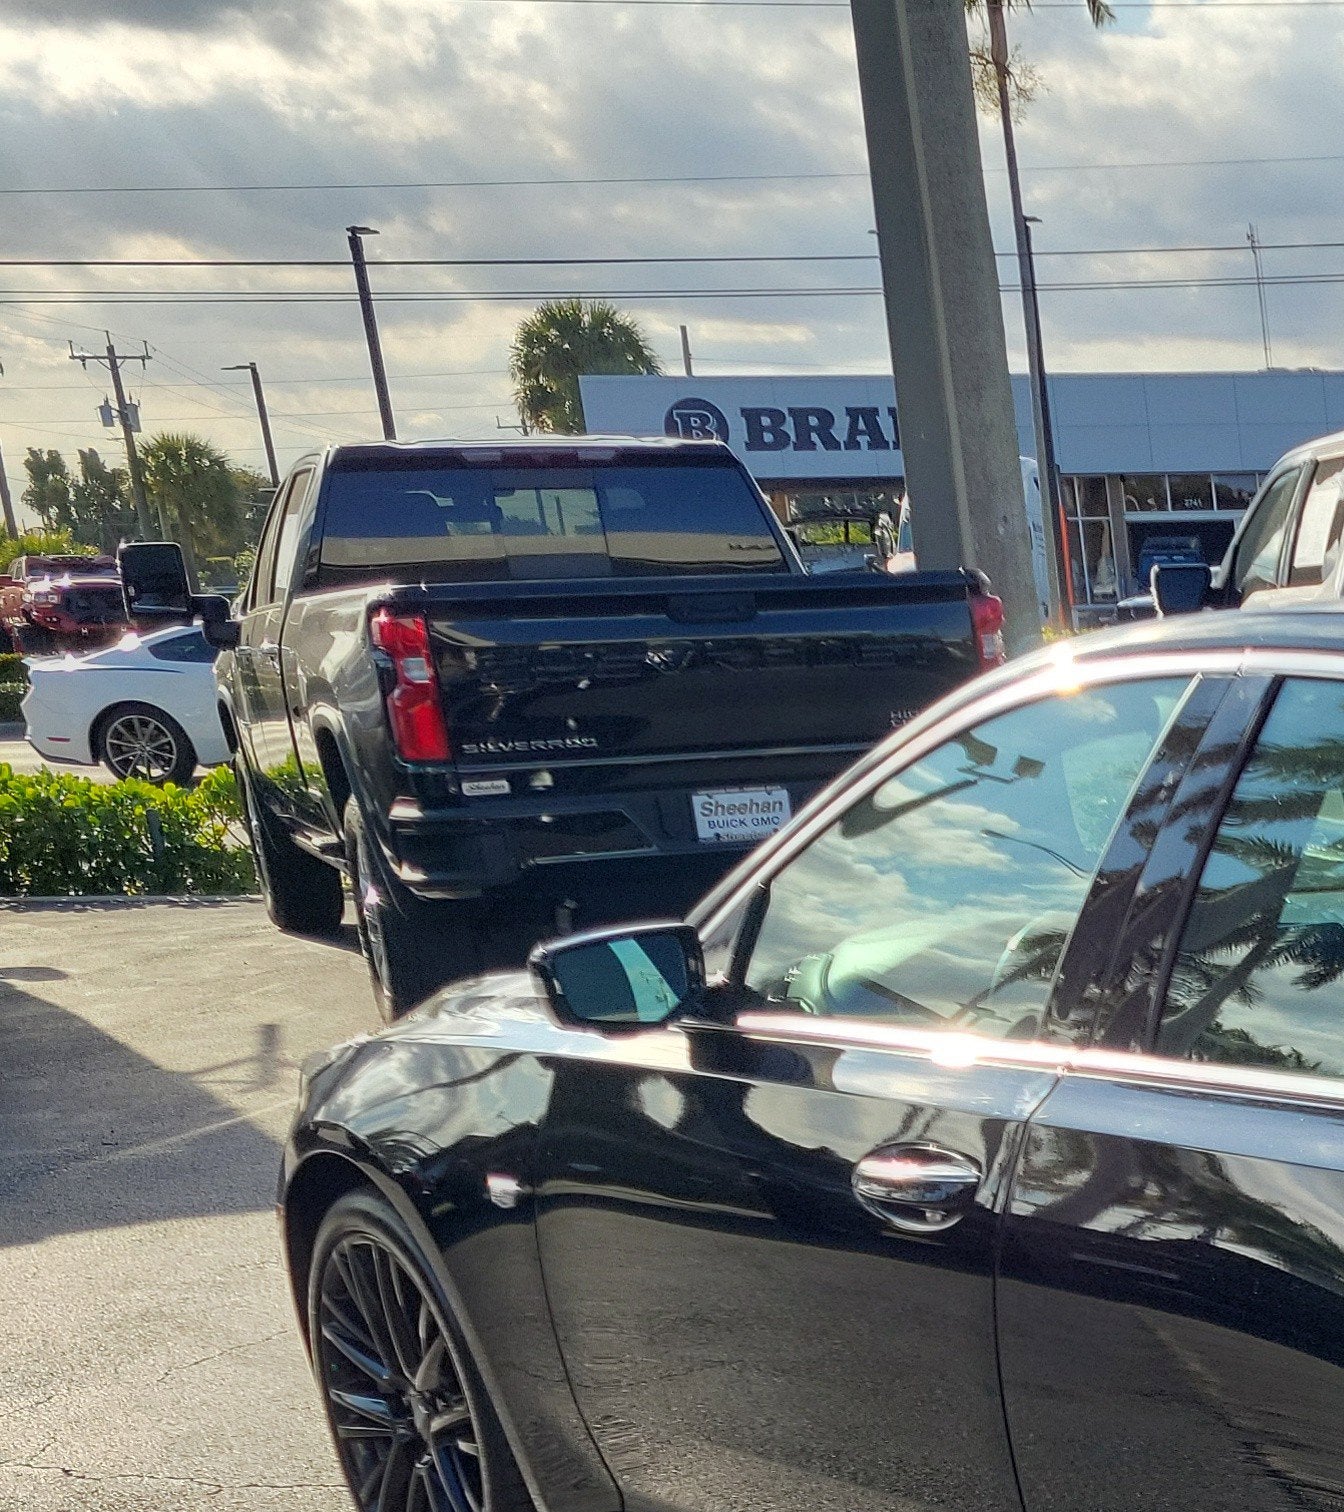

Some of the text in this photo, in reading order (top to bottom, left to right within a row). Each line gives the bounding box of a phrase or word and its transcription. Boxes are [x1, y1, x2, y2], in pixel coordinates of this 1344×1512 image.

[739, 406, 900, 451] BRA
[700, 799, 783, 817] Sheehan
[708, 816, 780, 829] BUICK GMC
